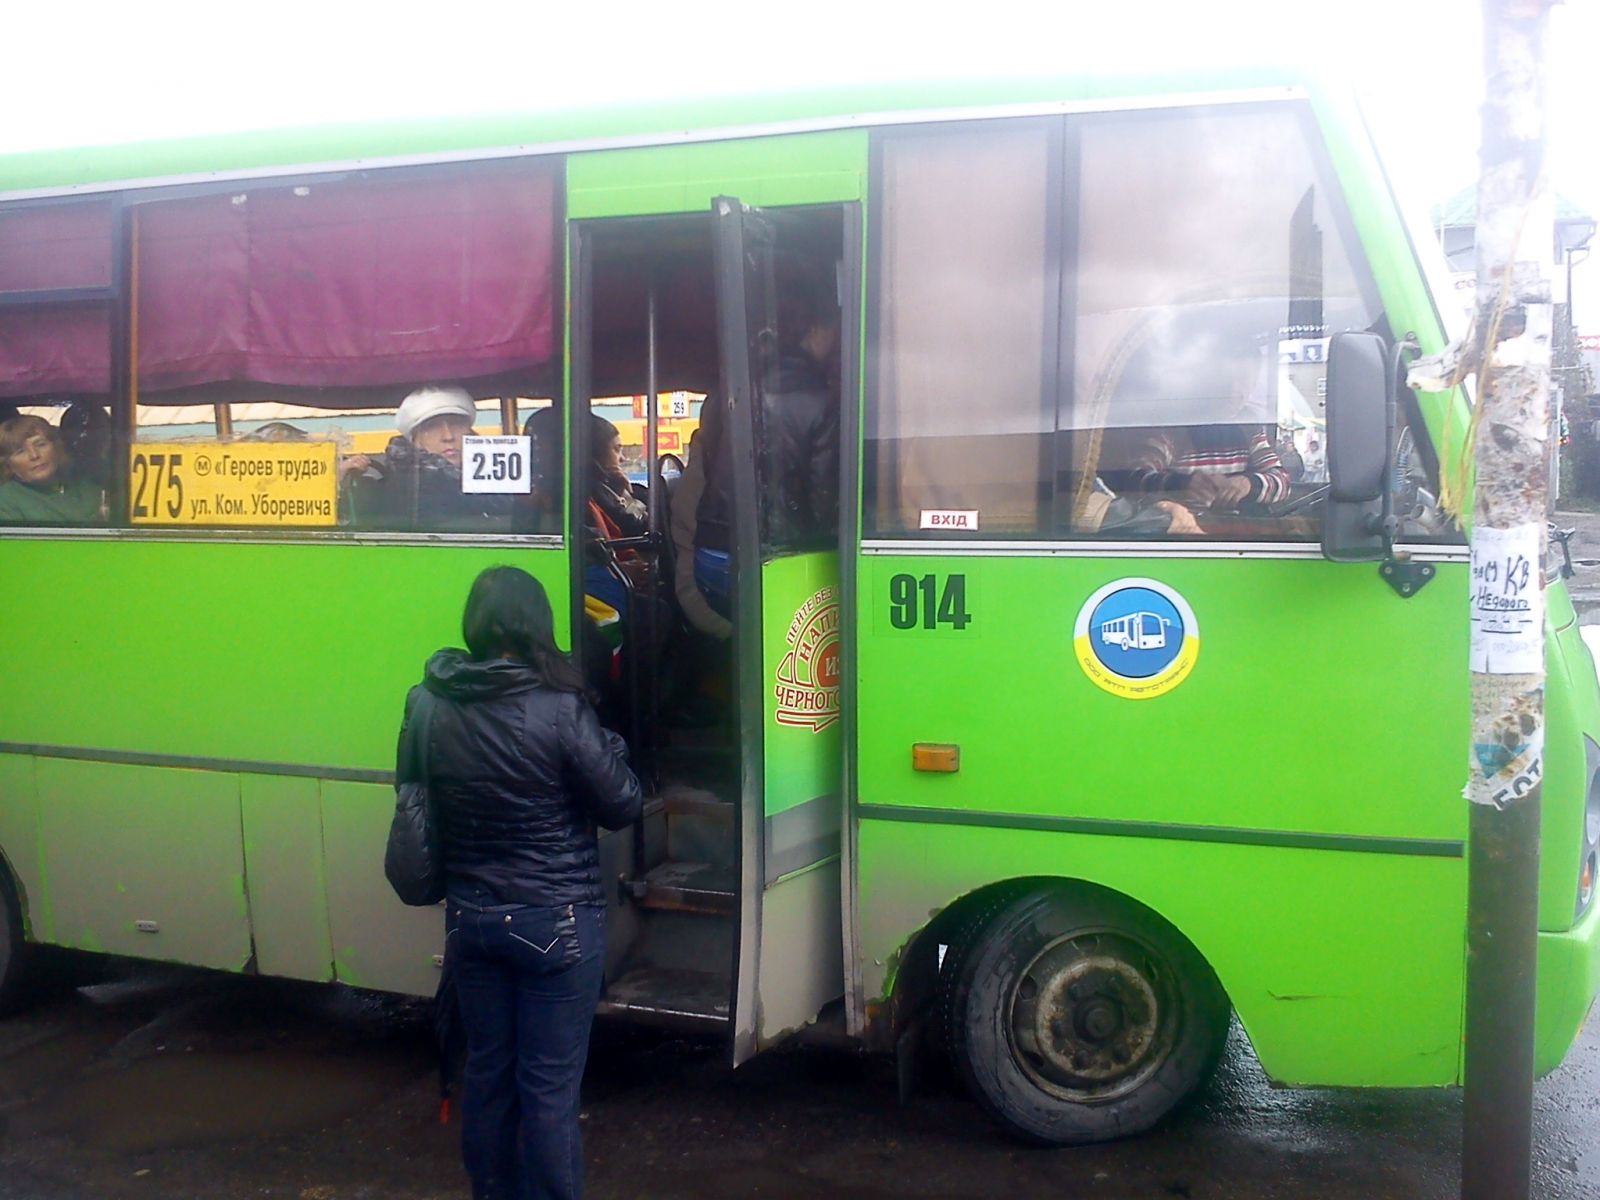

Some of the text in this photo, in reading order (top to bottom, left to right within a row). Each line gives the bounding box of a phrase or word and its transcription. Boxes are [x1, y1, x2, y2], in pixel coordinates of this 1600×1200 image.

[215, 455, 273, 480] «Героев
[277, 457, 328, 482] труда»
[472, 452, 522, 481] 2.50
[132, 453, 184, 519] 275
[191, 494, 331, 520] ул. Ком. Уборевича
[931, 514, 968, 527] ВХІД
[889, 573, 972, 630] 914
